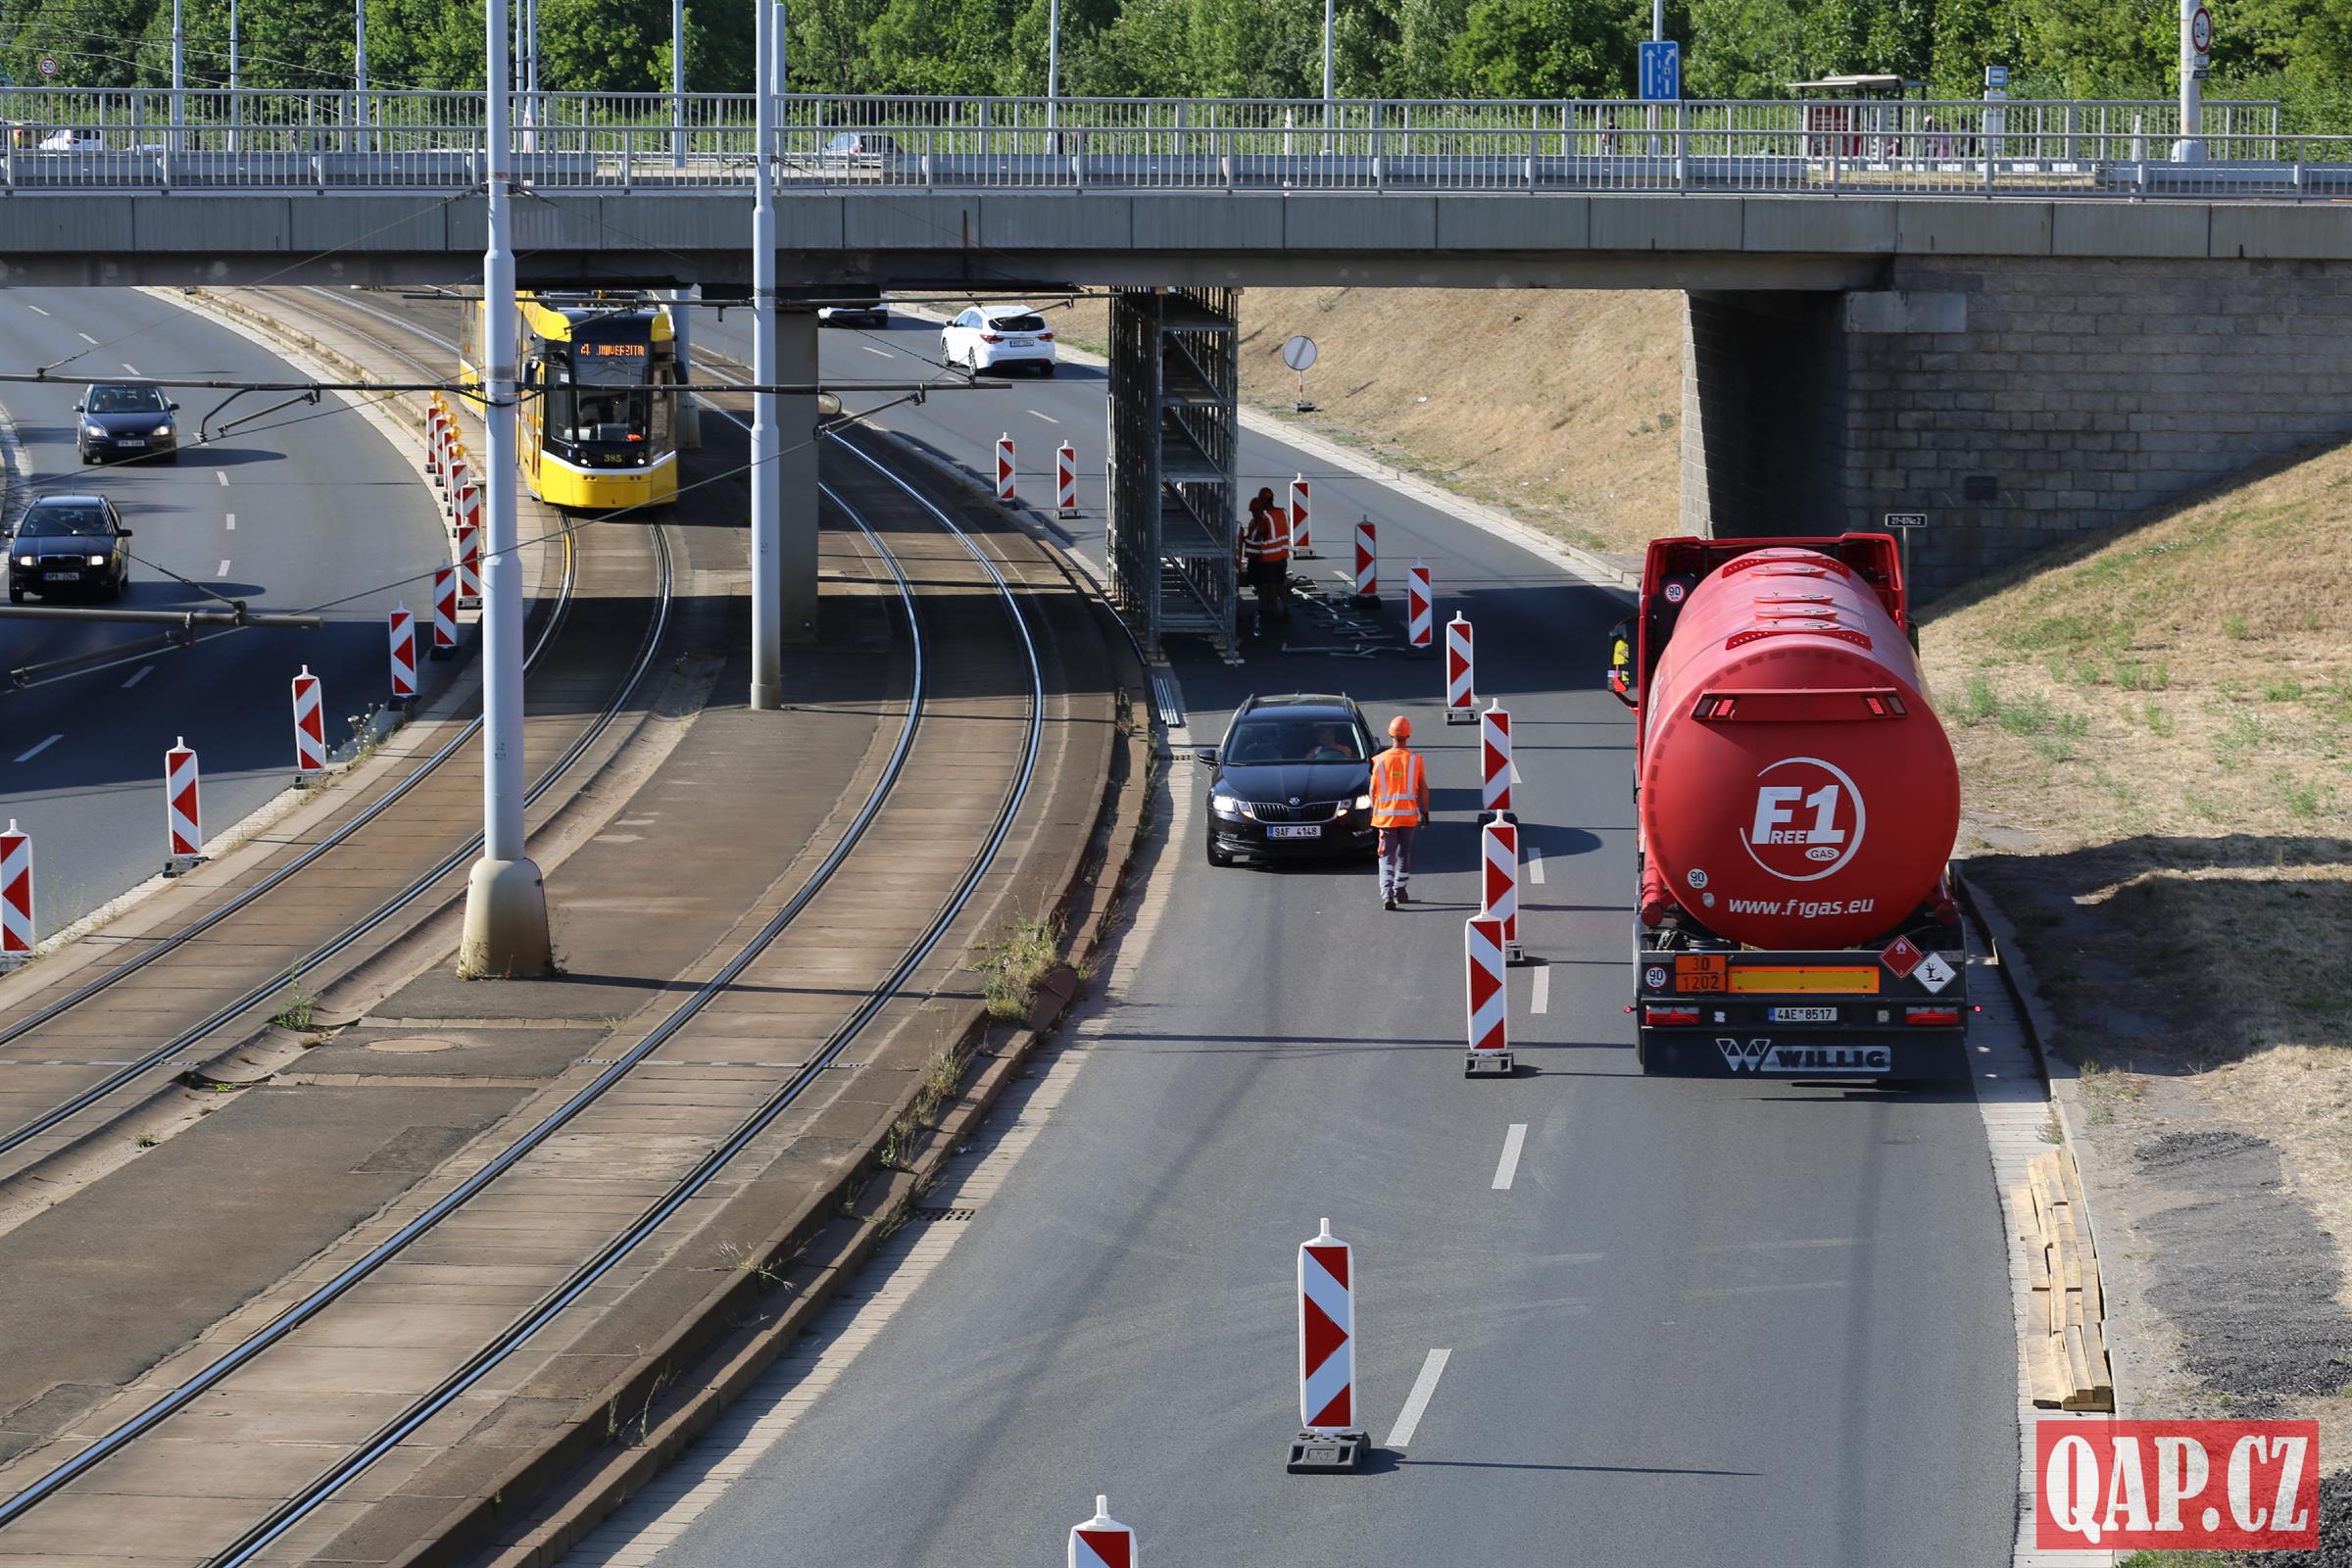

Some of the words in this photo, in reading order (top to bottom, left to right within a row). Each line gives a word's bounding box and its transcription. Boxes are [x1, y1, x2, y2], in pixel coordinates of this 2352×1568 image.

[43, 62, 54, 72] 50
[580, 343, 590, 356] 4
[1668, 586, 1681, 596] 90
[1275, 827, 1291, 837] 9AF
[1810, 849, 1835, 859] GAS
[1690, 871, 1705, 882] 90
[1729, 899, 1874, 918] www.f1gas.eu
[1692, 956, 1710, 971] 30
[1648, 969, 1664, 981] 90
[1684, 975, 1719, 990] 1202
[1777, 1008, 1797, 1020] 4AE
[1805, 1008, 1833, 1020] 8517
[1775, 1050, 1886, 1068] WILLIG
